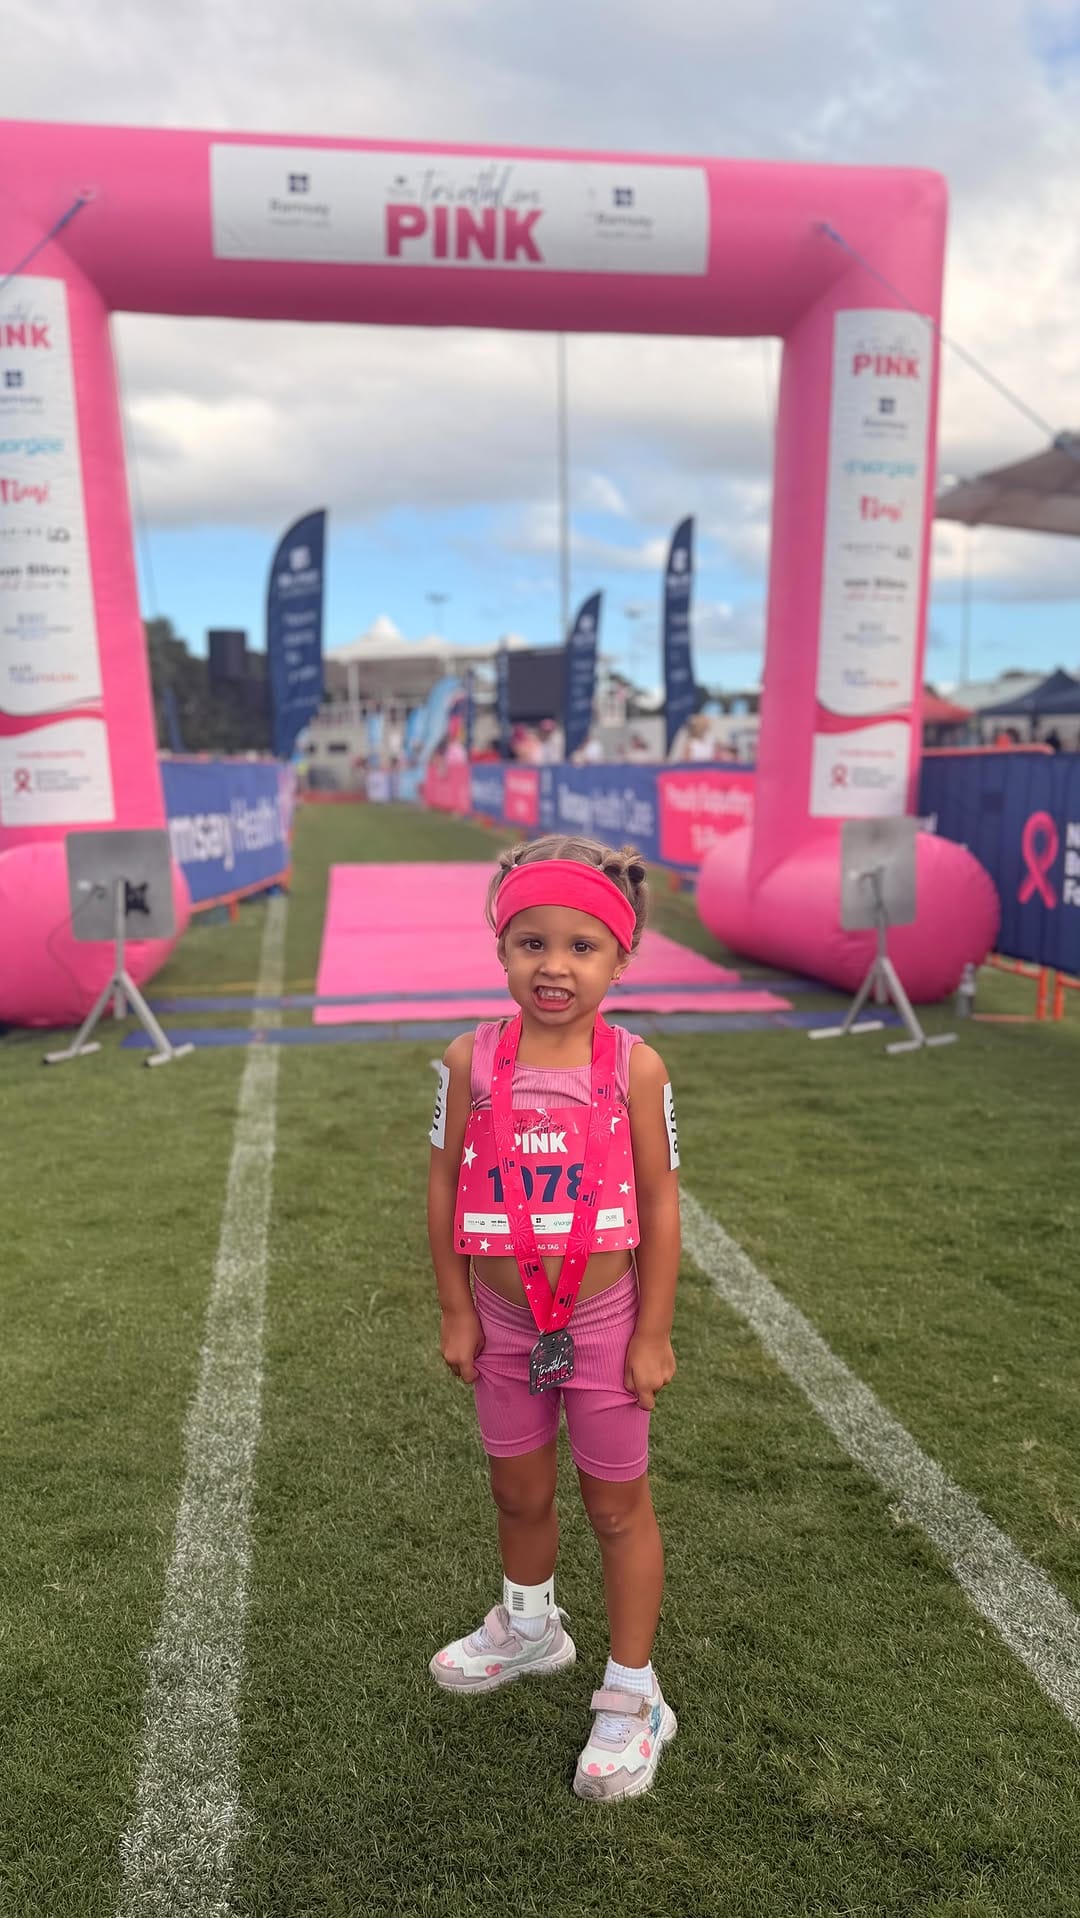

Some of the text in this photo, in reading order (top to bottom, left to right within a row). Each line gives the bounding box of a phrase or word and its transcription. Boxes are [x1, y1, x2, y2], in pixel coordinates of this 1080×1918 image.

[385, 204, 544, 262] PINK
[0, 323, 51, 348] NK
[852, 352, 920, 378] PINK
